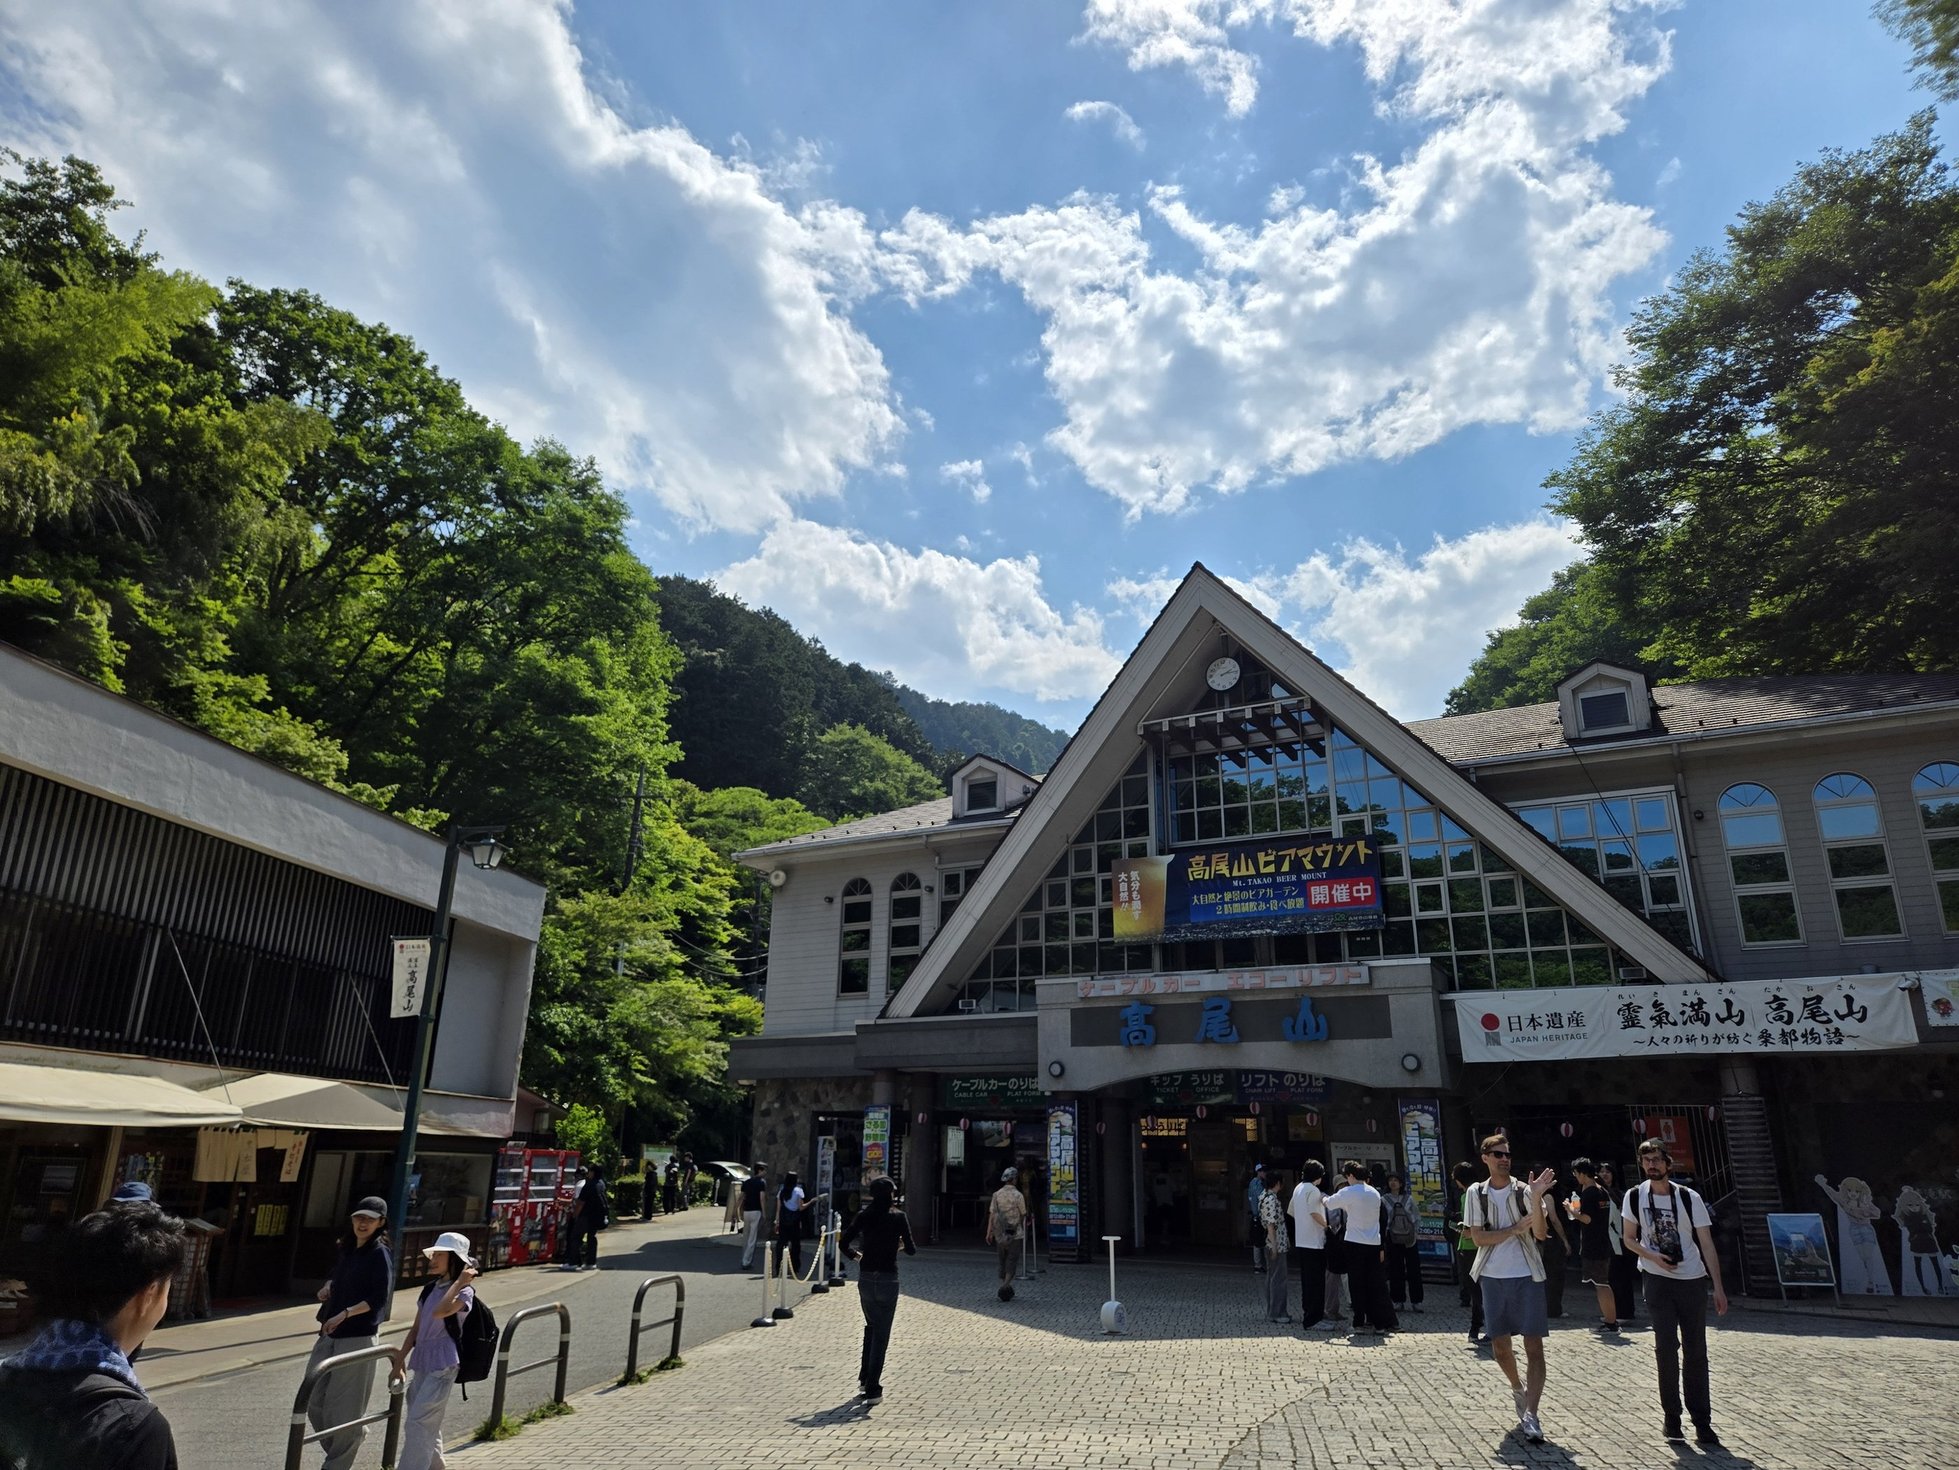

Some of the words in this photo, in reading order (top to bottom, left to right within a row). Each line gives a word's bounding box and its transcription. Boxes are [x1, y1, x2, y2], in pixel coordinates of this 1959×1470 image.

[1188, 840, 1373, 880] 高尾山ビアマウント
[1276, 874, 1297, 882] BEER
[1301, 871, 1327, 880] MOUNT
[1191, 886, 1300, 905] 大自然と絶景のビアガーデン
[1311, 882, 1372, 905] 開催中
[403, 969, 417, 1011] 高尾山
[1080, 976, 1200, 997] ケーブルカー
[1227, 967, 1361, 989] エコーリフト
[1119, 995, 1329, 1048] 高尾山
[1507, 1011, 1587, 1032] 日本遺産
[1764, 993, 1868, 1026] 高尾山
[1510, 1035, 1539, 1044] JAPAN
[1542, 1032, 1589, 1042] HERITAGE
[1190, 1072, 1225, 1086] うりば
[1241, 1073, 1279, 1087] リフト
[1050, 1121, 1061, 1195] ビアマウント
[1060, 1135, 1075, 1182] 高尾山
[1405, 1121, 1425, 1202] ビアマウント
[1420, 1138, 1442, 1190] 高尾山
